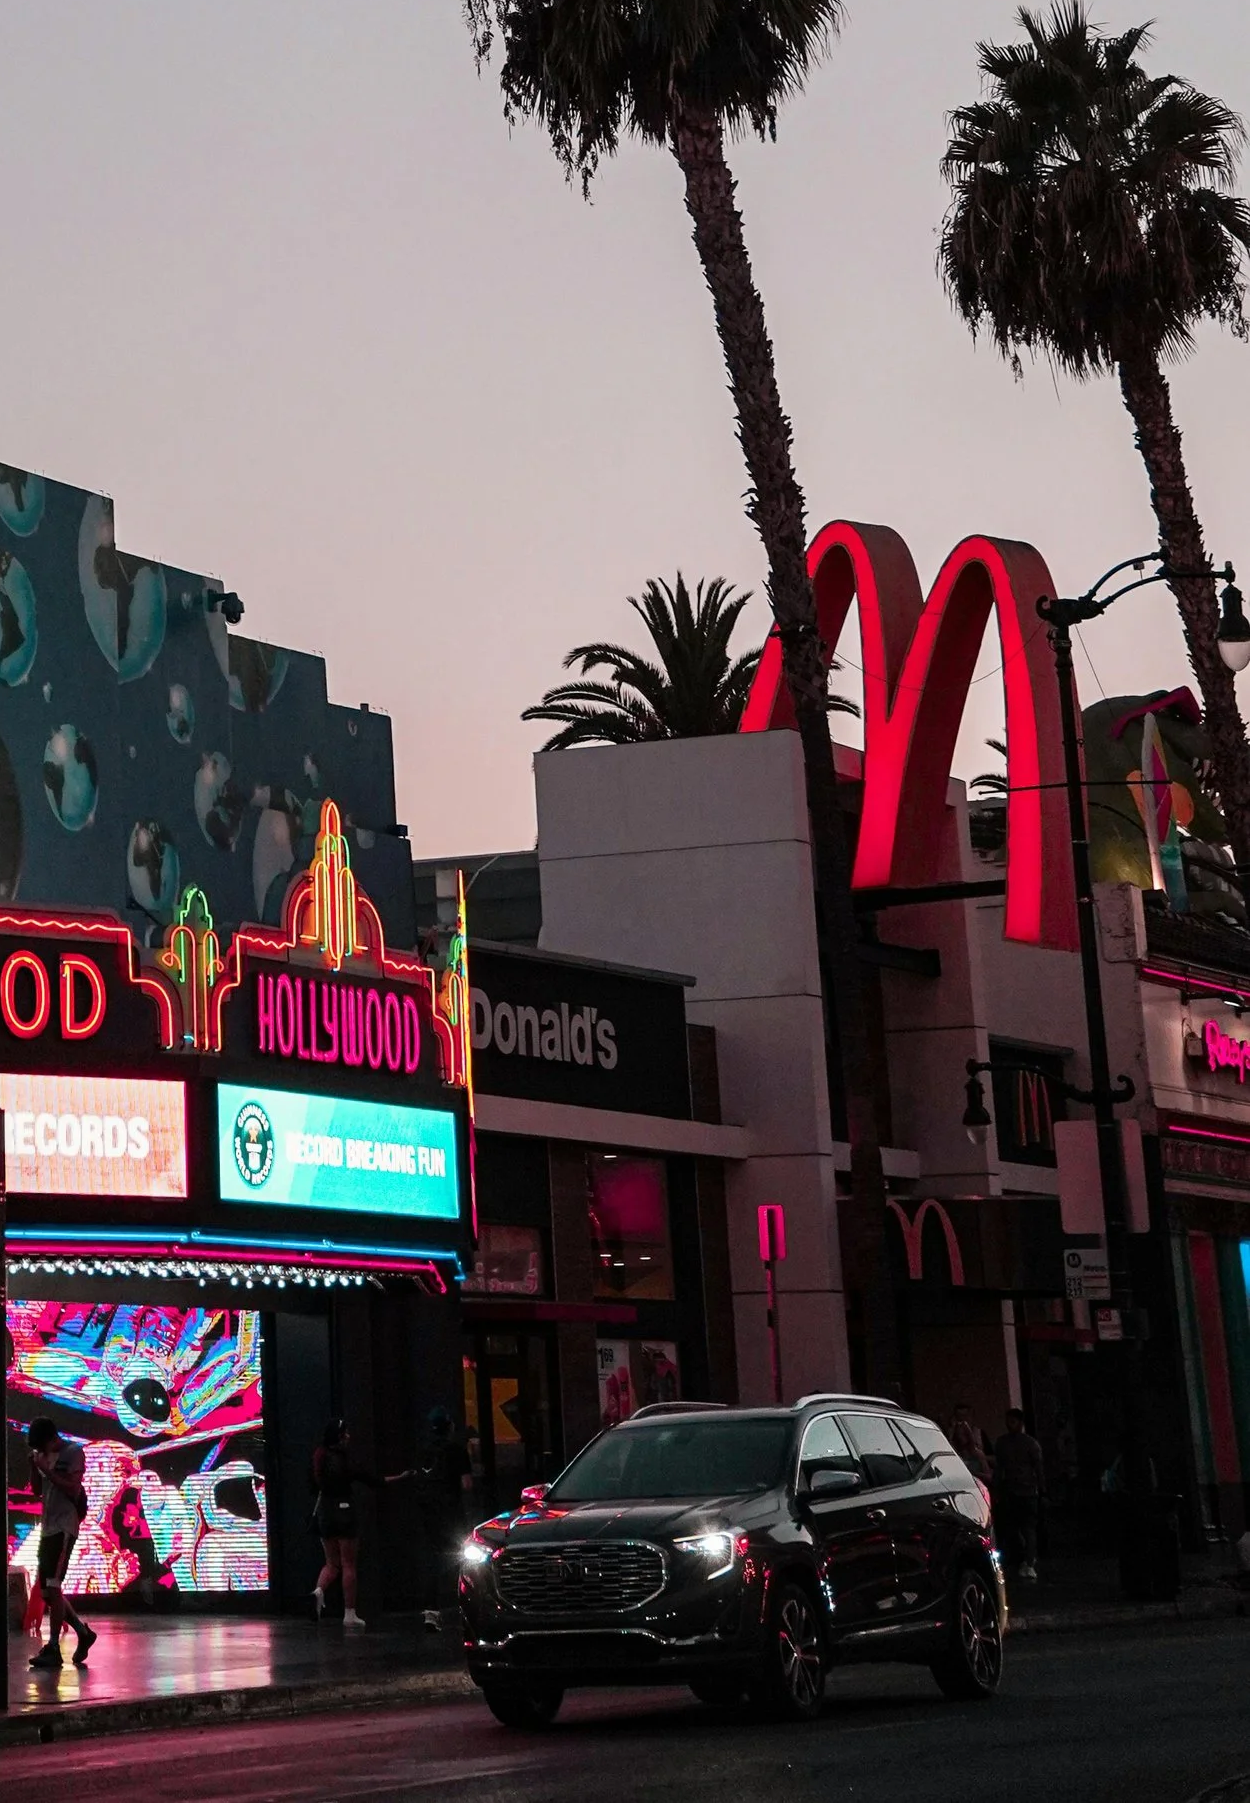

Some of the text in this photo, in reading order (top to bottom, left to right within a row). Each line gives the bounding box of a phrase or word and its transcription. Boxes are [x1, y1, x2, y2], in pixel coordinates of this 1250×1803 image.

[258, 973, 421, 1074] HOLLYWOOD
[345, 1138, 416, 1175] BREAKING
[418, 1146, 446, 1178] FUN
